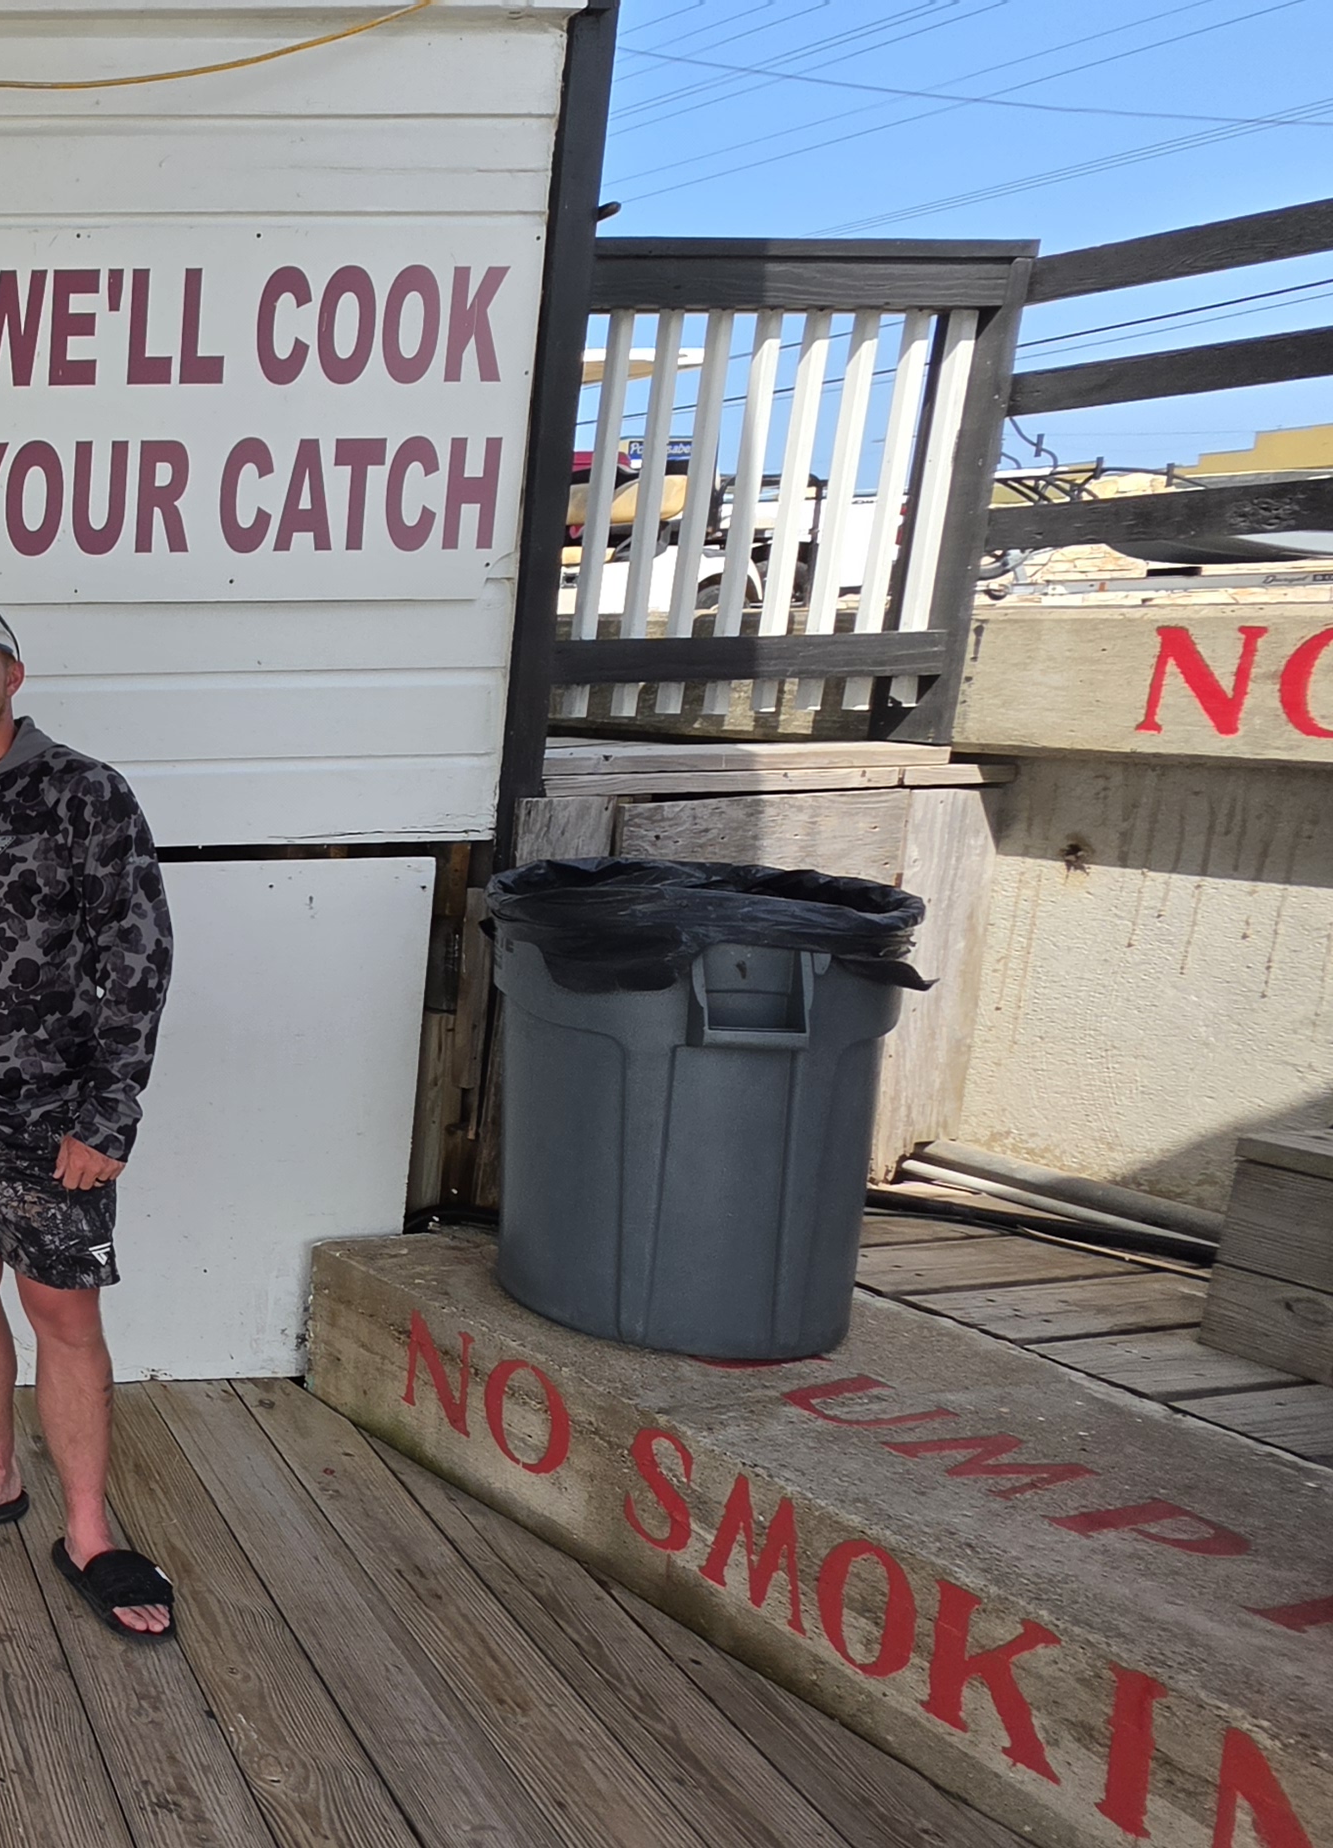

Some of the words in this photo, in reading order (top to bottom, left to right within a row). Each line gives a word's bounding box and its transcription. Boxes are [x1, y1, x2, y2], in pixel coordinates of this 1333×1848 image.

[256, 264, 511, 385] COOK
[219, 435, 504, 553] CATCH
[401, 1310, 571, 1475] NO
